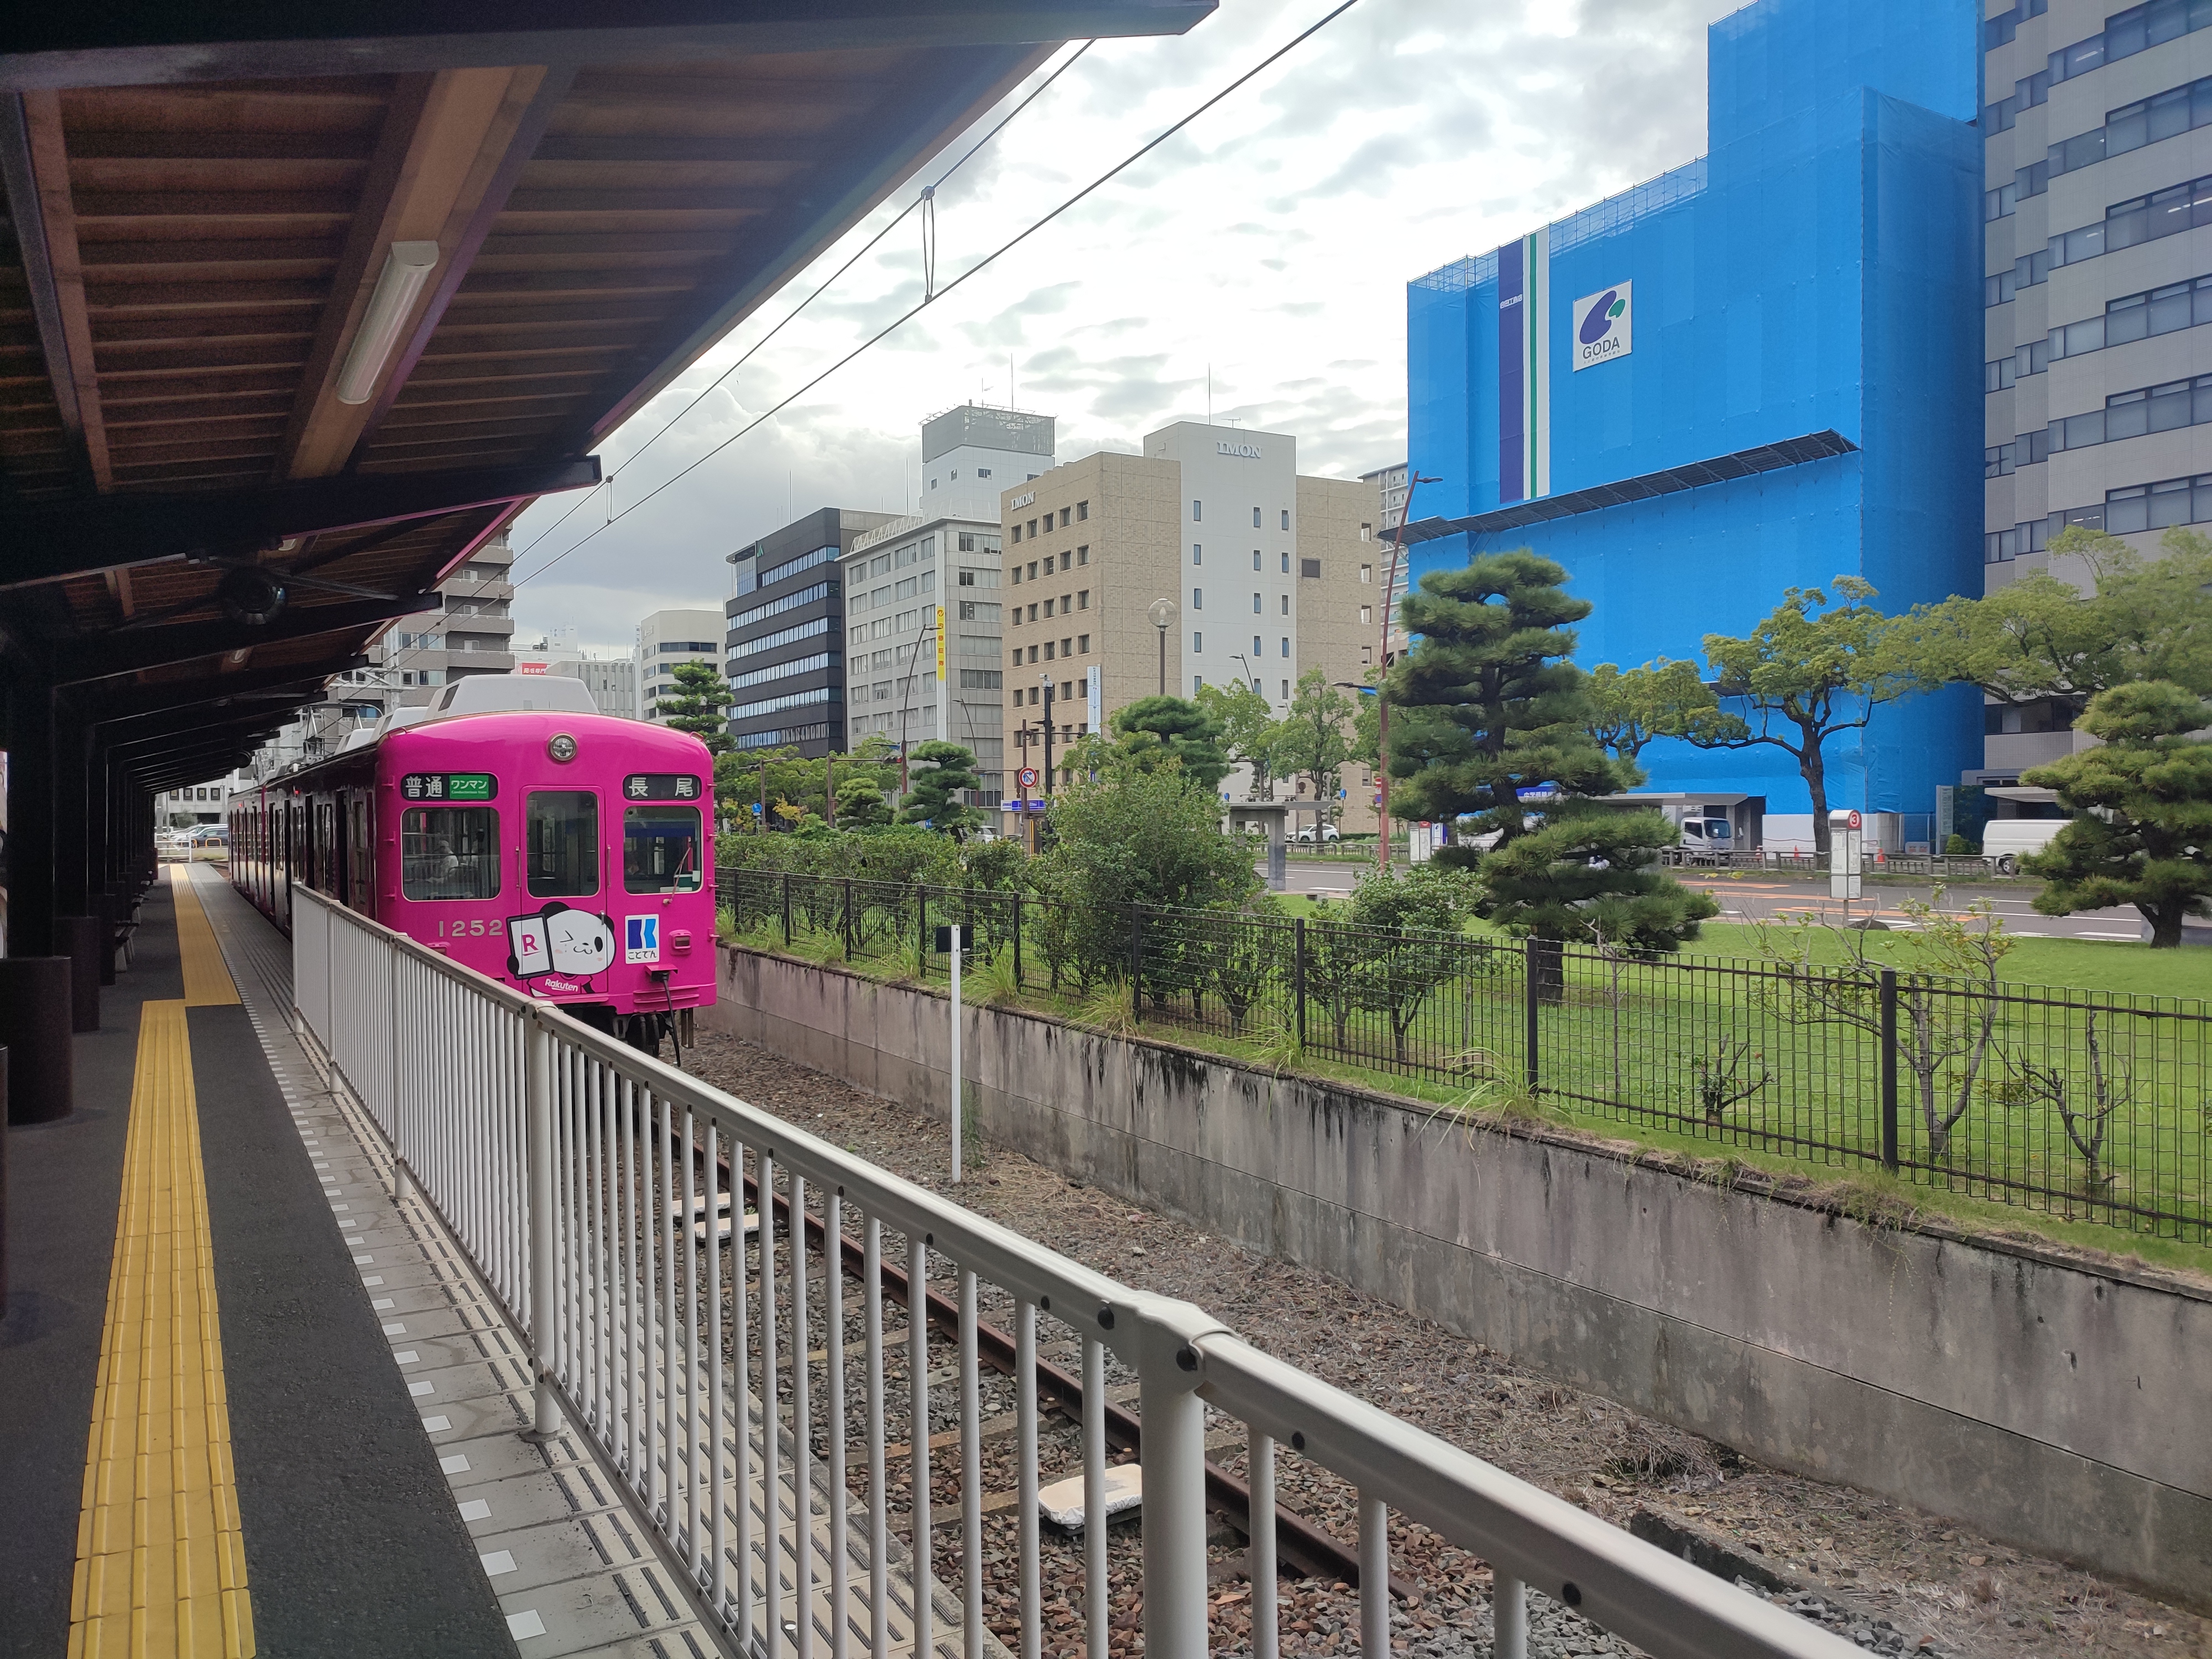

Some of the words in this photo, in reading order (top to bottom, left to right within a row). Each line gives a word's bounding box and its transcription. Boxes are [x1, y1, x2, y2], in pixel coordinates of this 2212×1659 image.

[1583, 336, 1620, 359] GODA
[1217, 441, 1262, 458] IMON
[1011, 491, 1035, 511] IMON
[405, 776, 442, 797] 普通
[451, 780, 487, 790] ワンマン
[628, 777, 693, 796] 長尾
[1851, 814, 1857, 825] 3
[439, 920, 503, 937] 1252
[522, 934, 539, 952] R
[628, 951, 658, 960] ことでん
[545, 978, 578, 992] Rakuten
